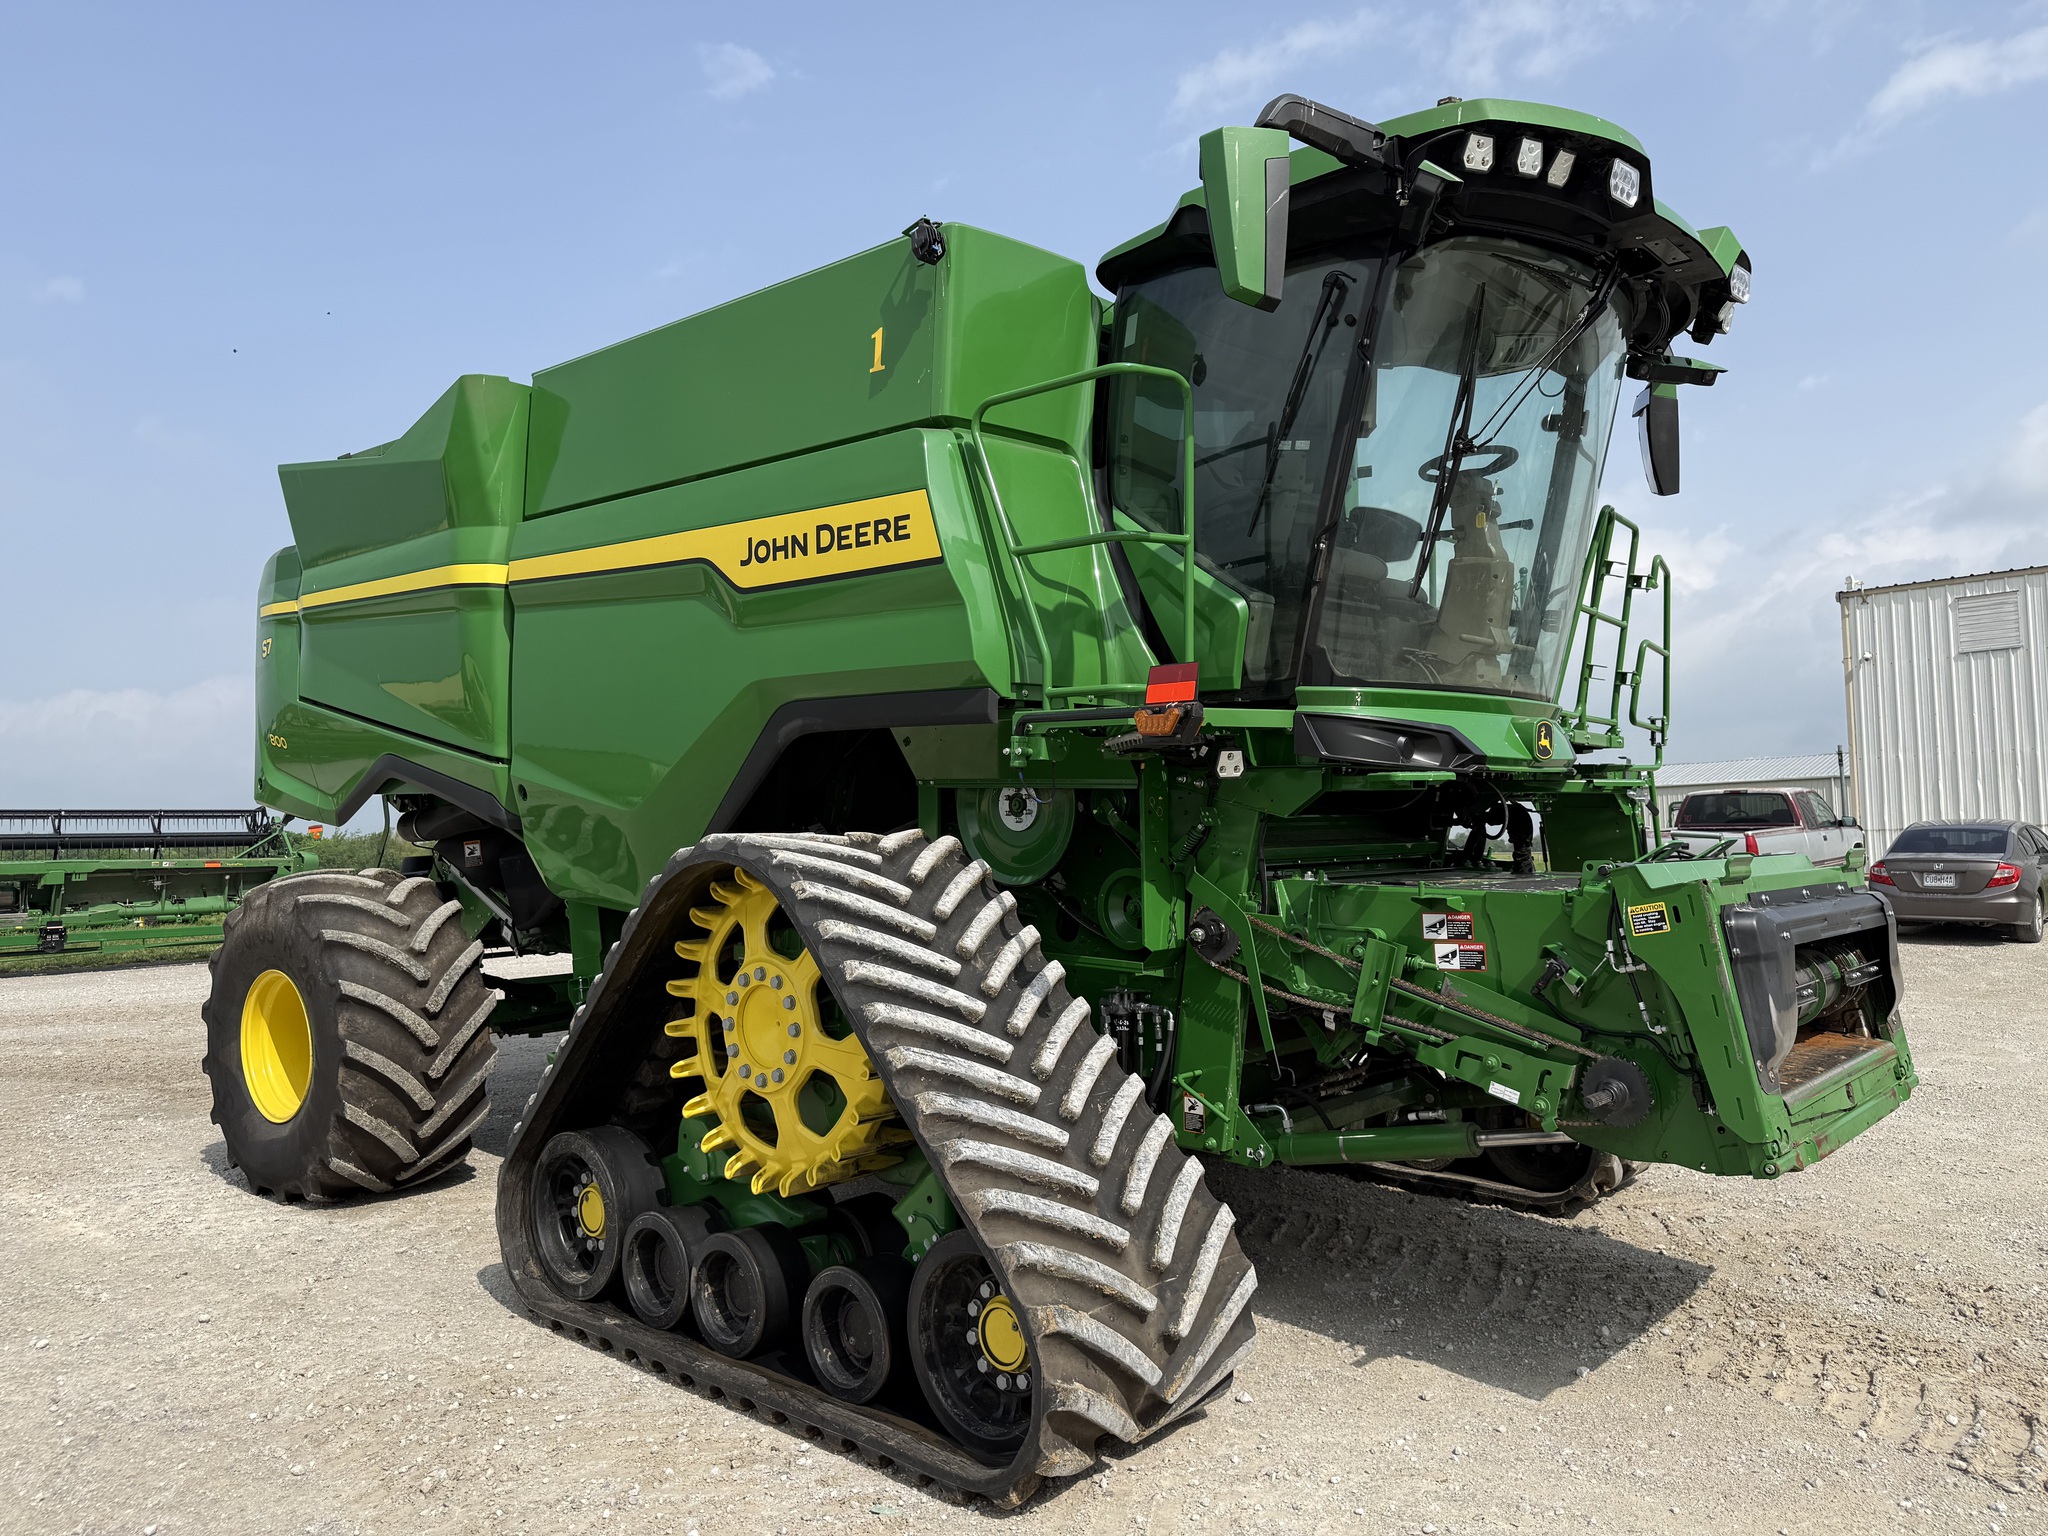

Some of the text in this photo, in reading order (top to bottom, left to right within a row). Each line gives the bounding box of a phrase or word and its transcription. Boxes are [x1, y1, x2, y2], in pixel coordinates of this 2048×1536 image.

[869, 326, 886, 373] 1
[740, 514, 911, 567] JOHN DEERE
[262, 637, 273, 658] S7
[1634, 903, 1664, 913] CAUTION
